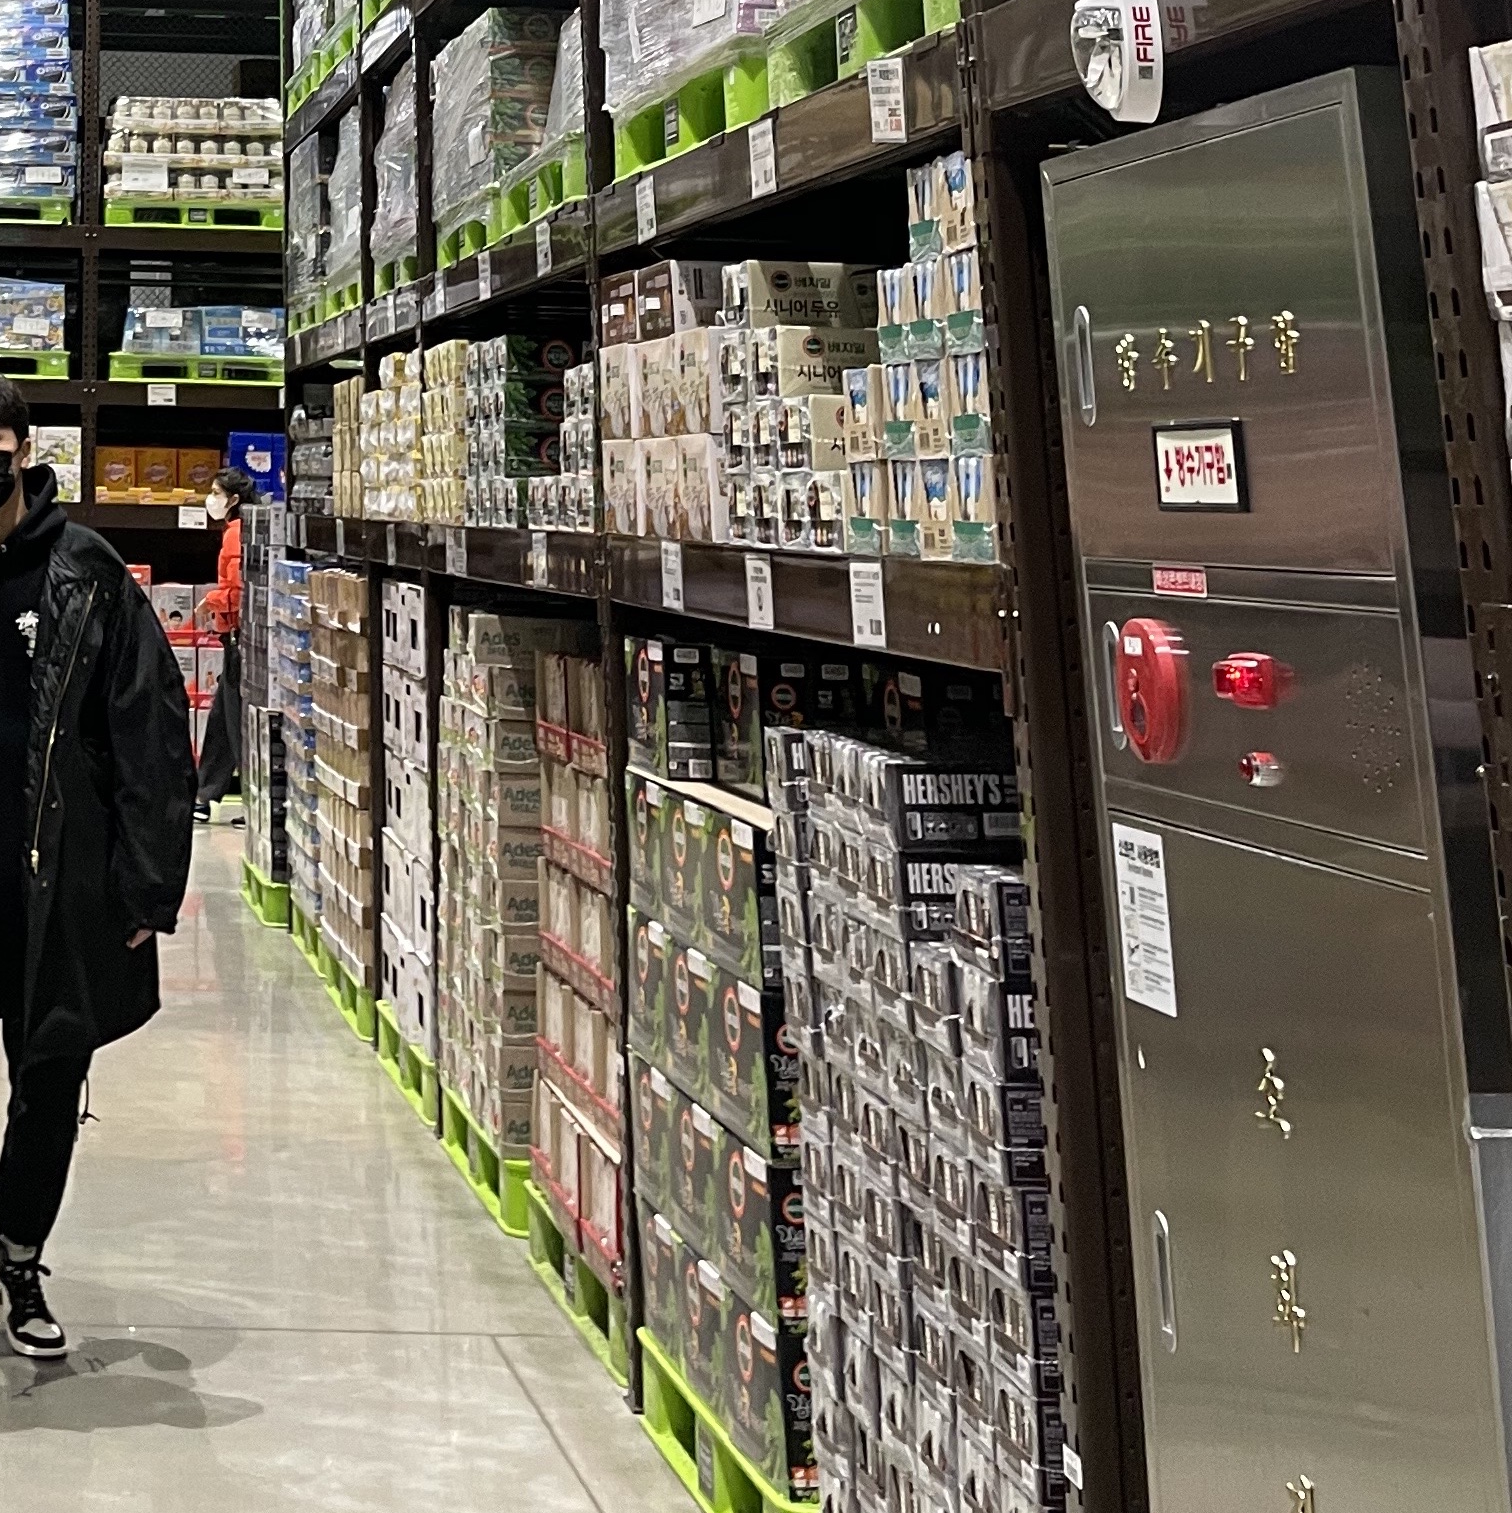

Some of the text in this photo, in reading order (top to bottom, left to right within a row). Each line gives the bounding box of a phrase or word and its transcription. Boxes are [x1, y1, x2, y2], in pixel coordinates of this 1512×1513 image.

[1131, 6, 1155, 63] FIRE
[828, 342, 866, 354] 베지밀
[1175, 442, 1226, 487] 방수기구함
[902, 774, 1002, 805] HERSHEY'S
